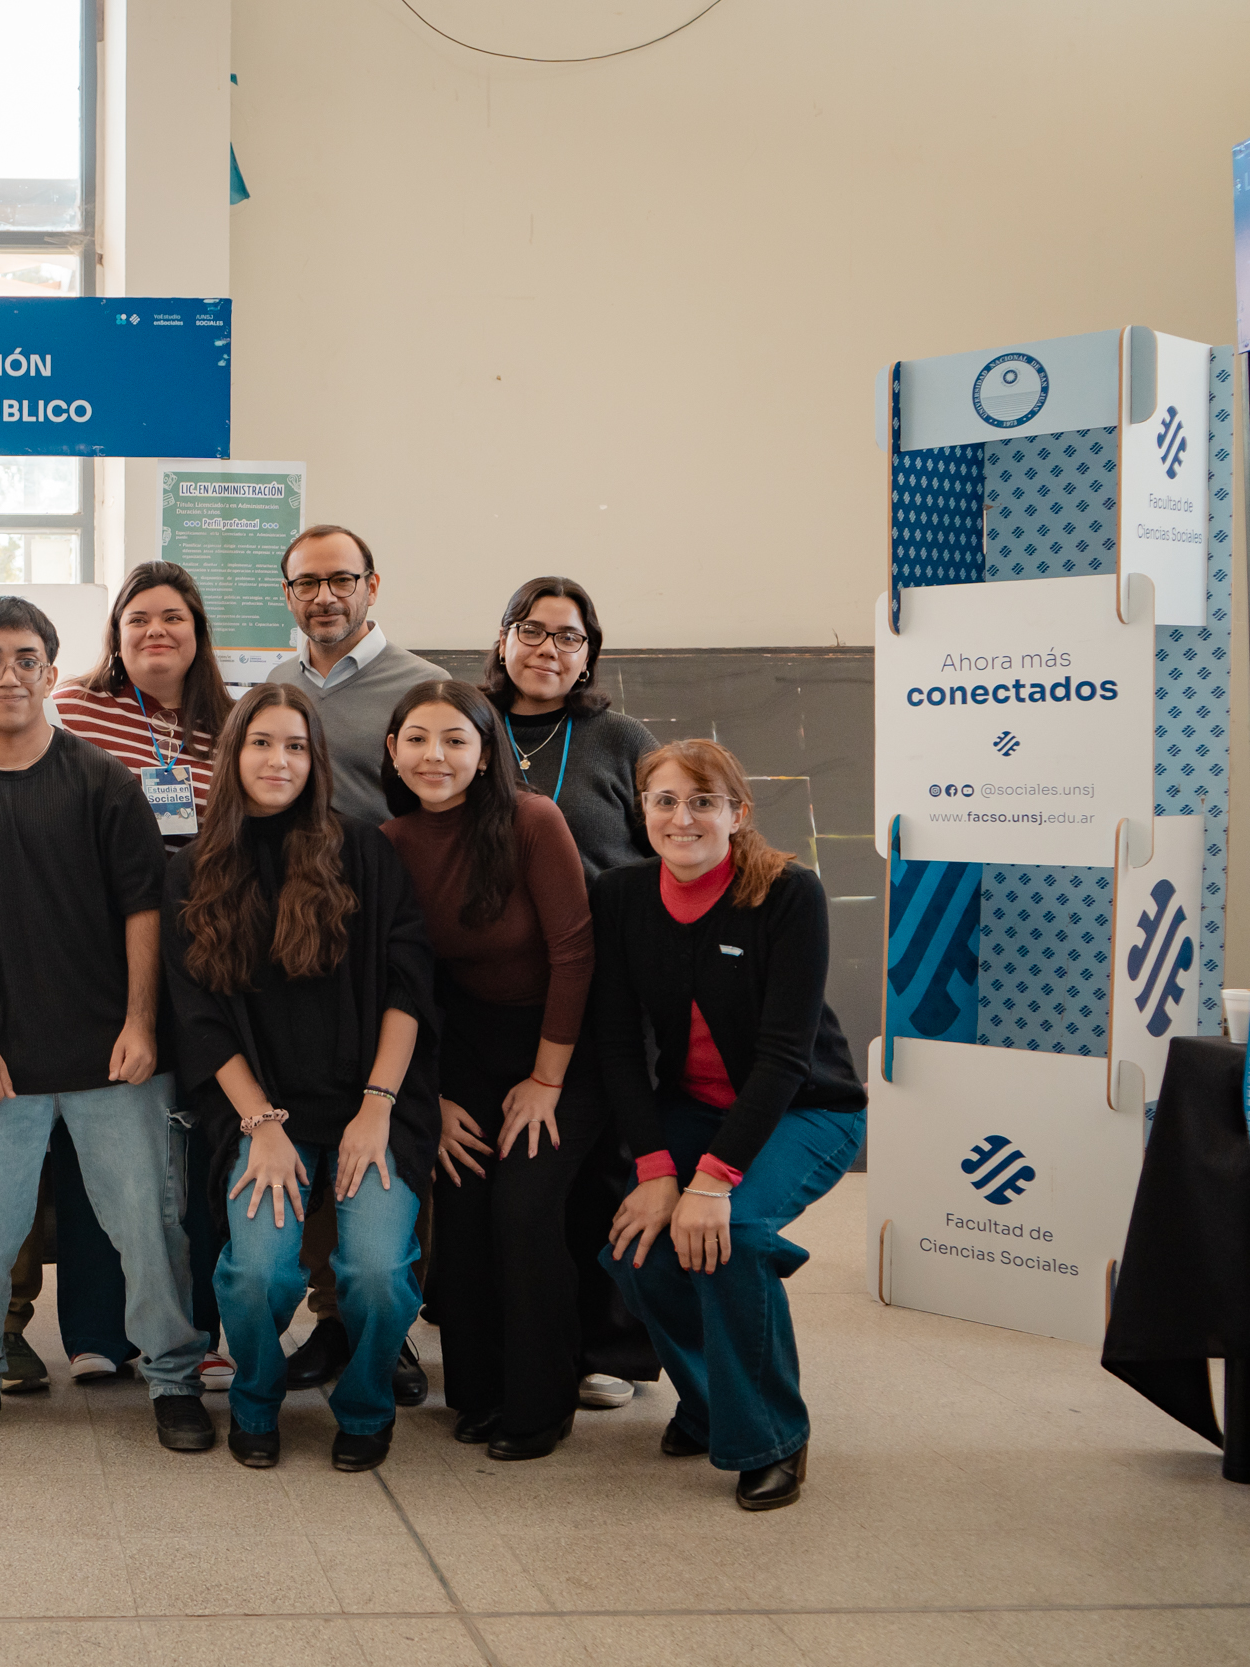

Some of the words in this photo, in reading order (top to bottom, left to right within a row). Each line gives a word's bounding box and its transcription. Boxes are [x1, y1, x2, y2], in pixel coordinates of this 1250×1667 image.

[989, 354, 1028, 369] NACIONAL
[180, 483, 196, 495] LIC.
[198, 484, 209, 495] EN
[211, 482, 284, 497] ADMINISTRACIÓN
[1149, 493, 1182, 511] Facultad
[1183, 498, 1194, 513] de
[203, 519, 221, 527] Perfil
[222, 519, 258, 530] profesional
[1137, 523, 1170, 541] Ciencias
[1171, 527, 1203, 544] Sociales
[940, 653, 1013, 672] Ahora
[1021, 647, 1072, 669] más
[906, 675, 1119, 707] conectados
[147, 786, 178, 794] Estudiá
[980, 783, 1095, 799] @sociales.unsj
[148, 794, 191, 803] Sociales
[929, 811, 1096, 826] www.facso.unsj.edu.ar
[946, 1212, 1024, 1238] Facultad
[1029, 1226, 1054, 1242] de
[919, 1237, 995, 1263] Ciencias
[1000, 1250, 1079, 1276] Sociales
